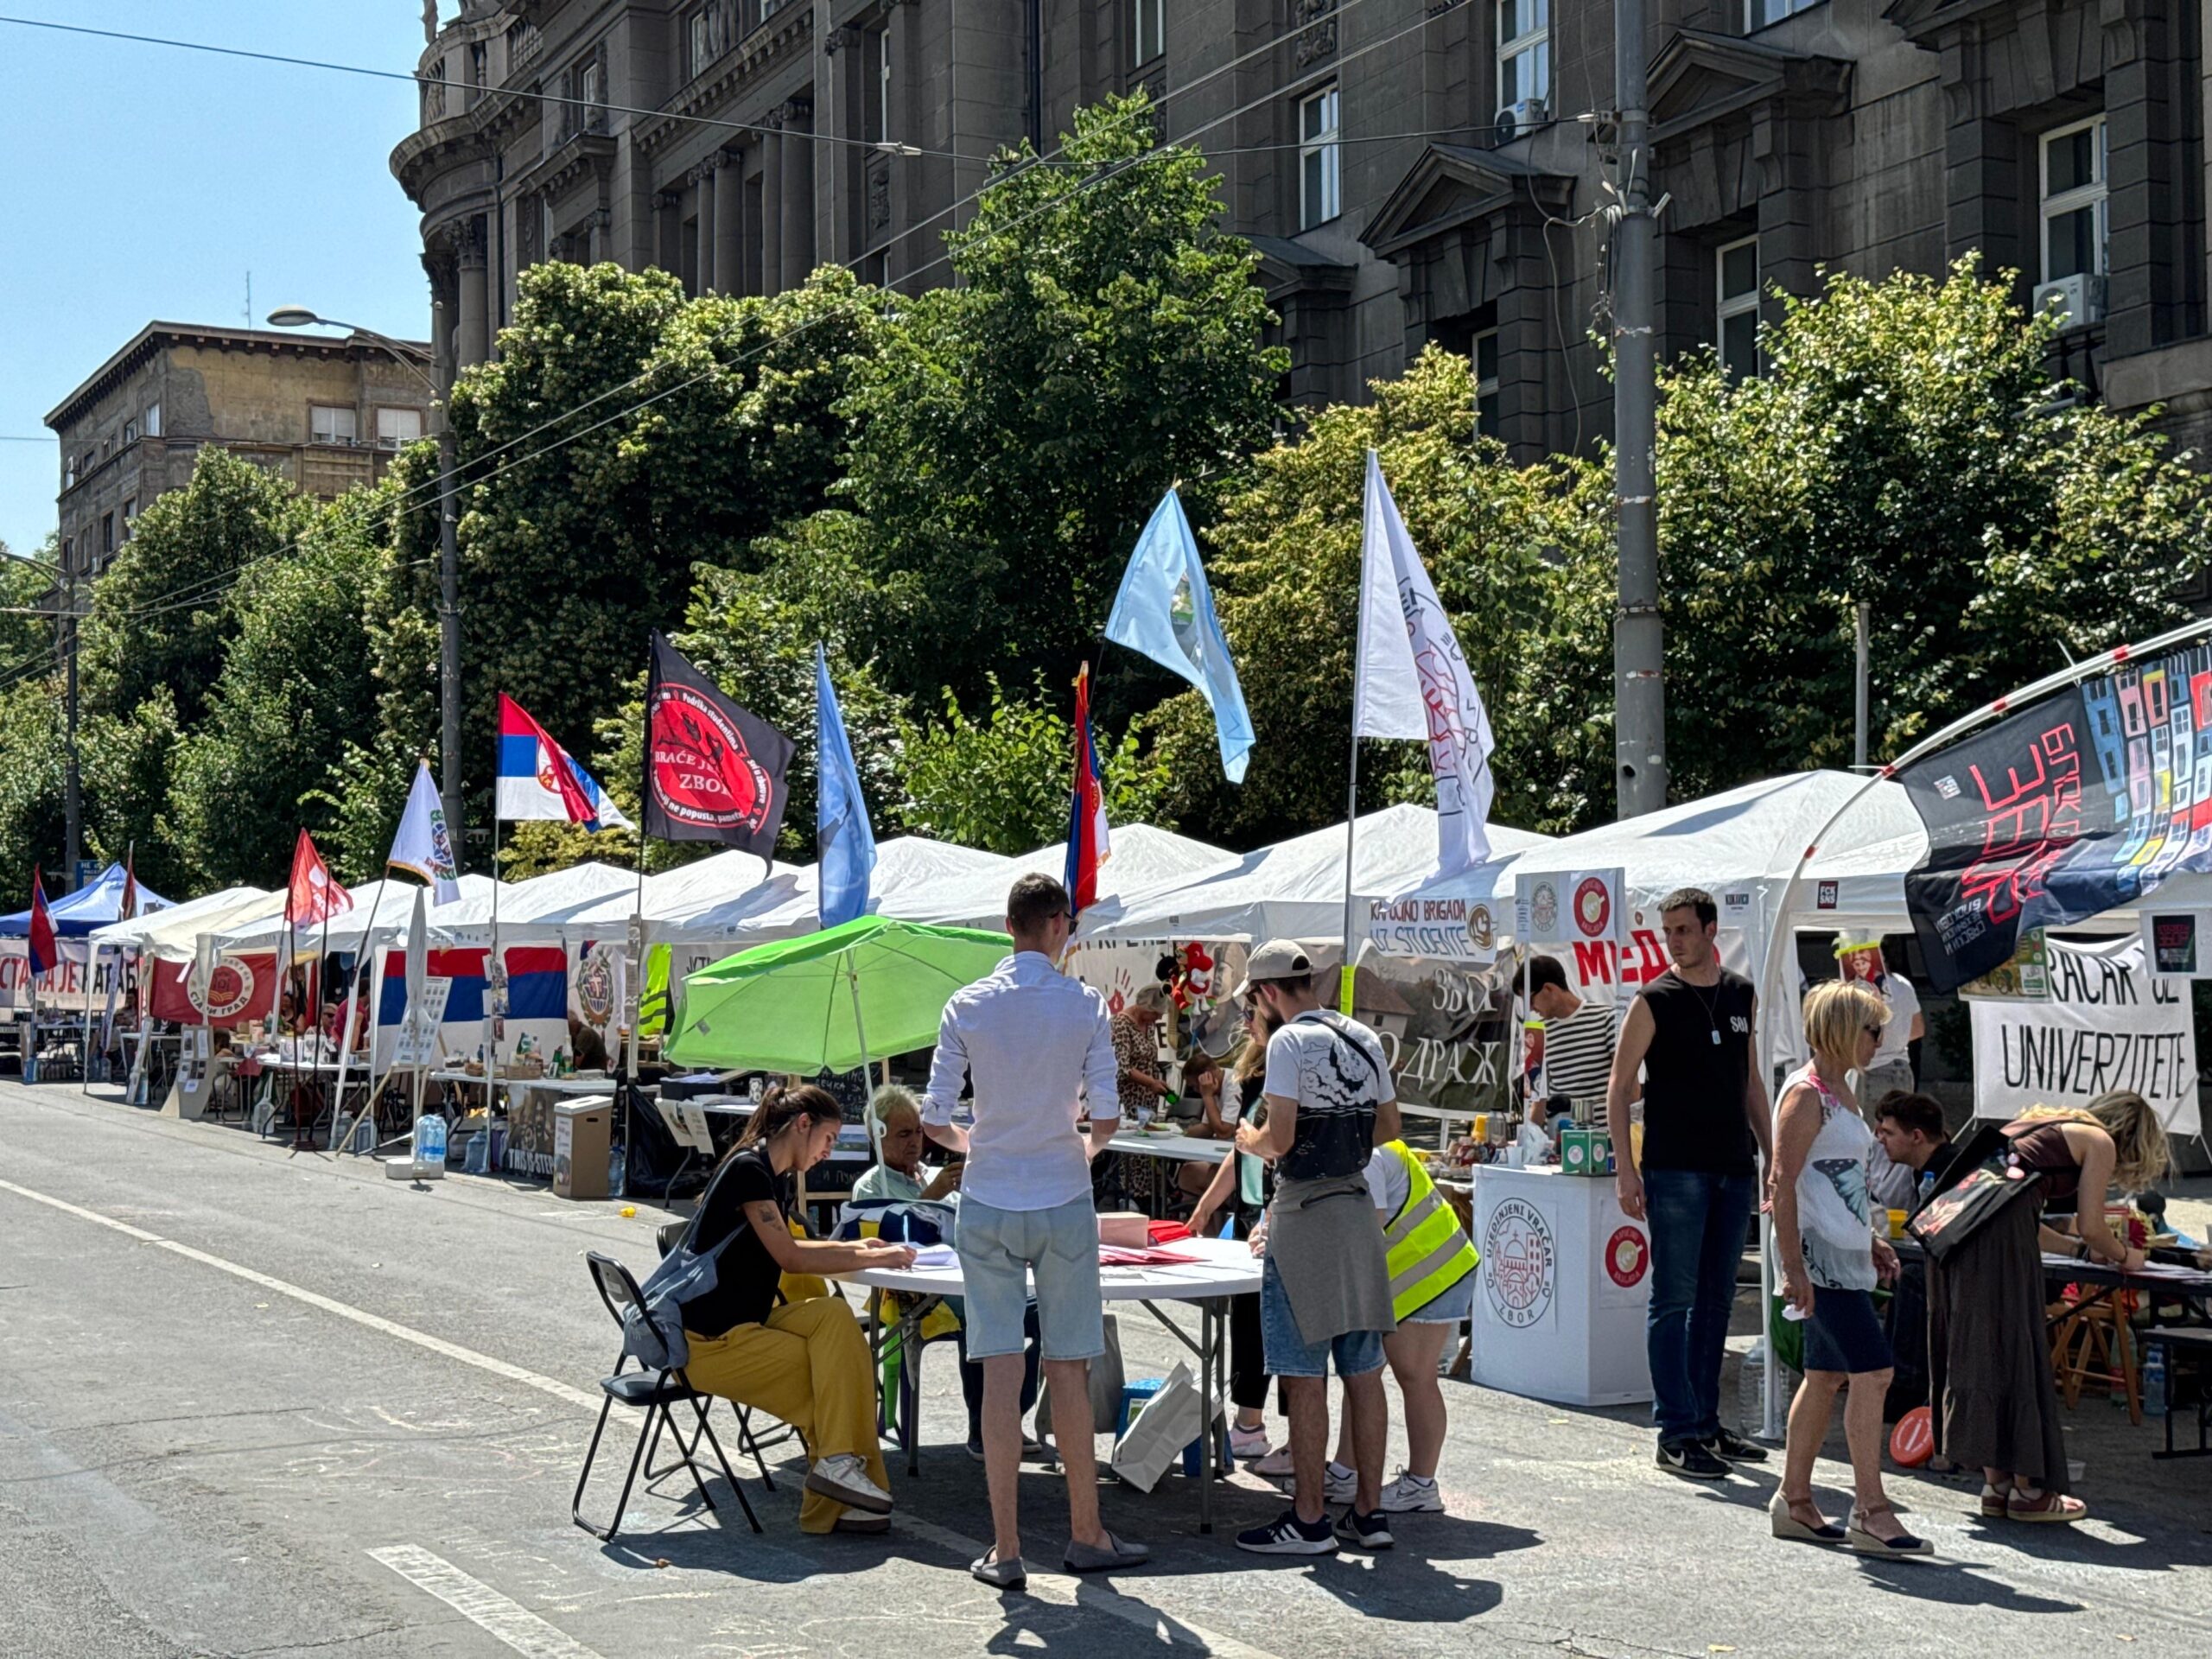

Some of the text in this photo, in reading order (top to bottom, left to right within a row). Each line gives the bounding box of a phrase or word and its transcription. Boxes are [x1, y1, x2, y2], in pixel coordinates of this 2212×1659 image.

[1819, 894, 1835, 905] SNS
[1820, 885, 1836, 896] FCK
[1423, 899, 1467, 922] BRIGADA
[1370, 925, 1476, 957] UZ STUDENTE
[221, 996, 249, 1015] ГРАД
[2000, 1023, 2185, 1100] UNIVERZITETE
[1485, 1202, 1553, 1268] UJEDINJENI VRAČAR
[1498, 1303, 1535, 1324] ZBOR
